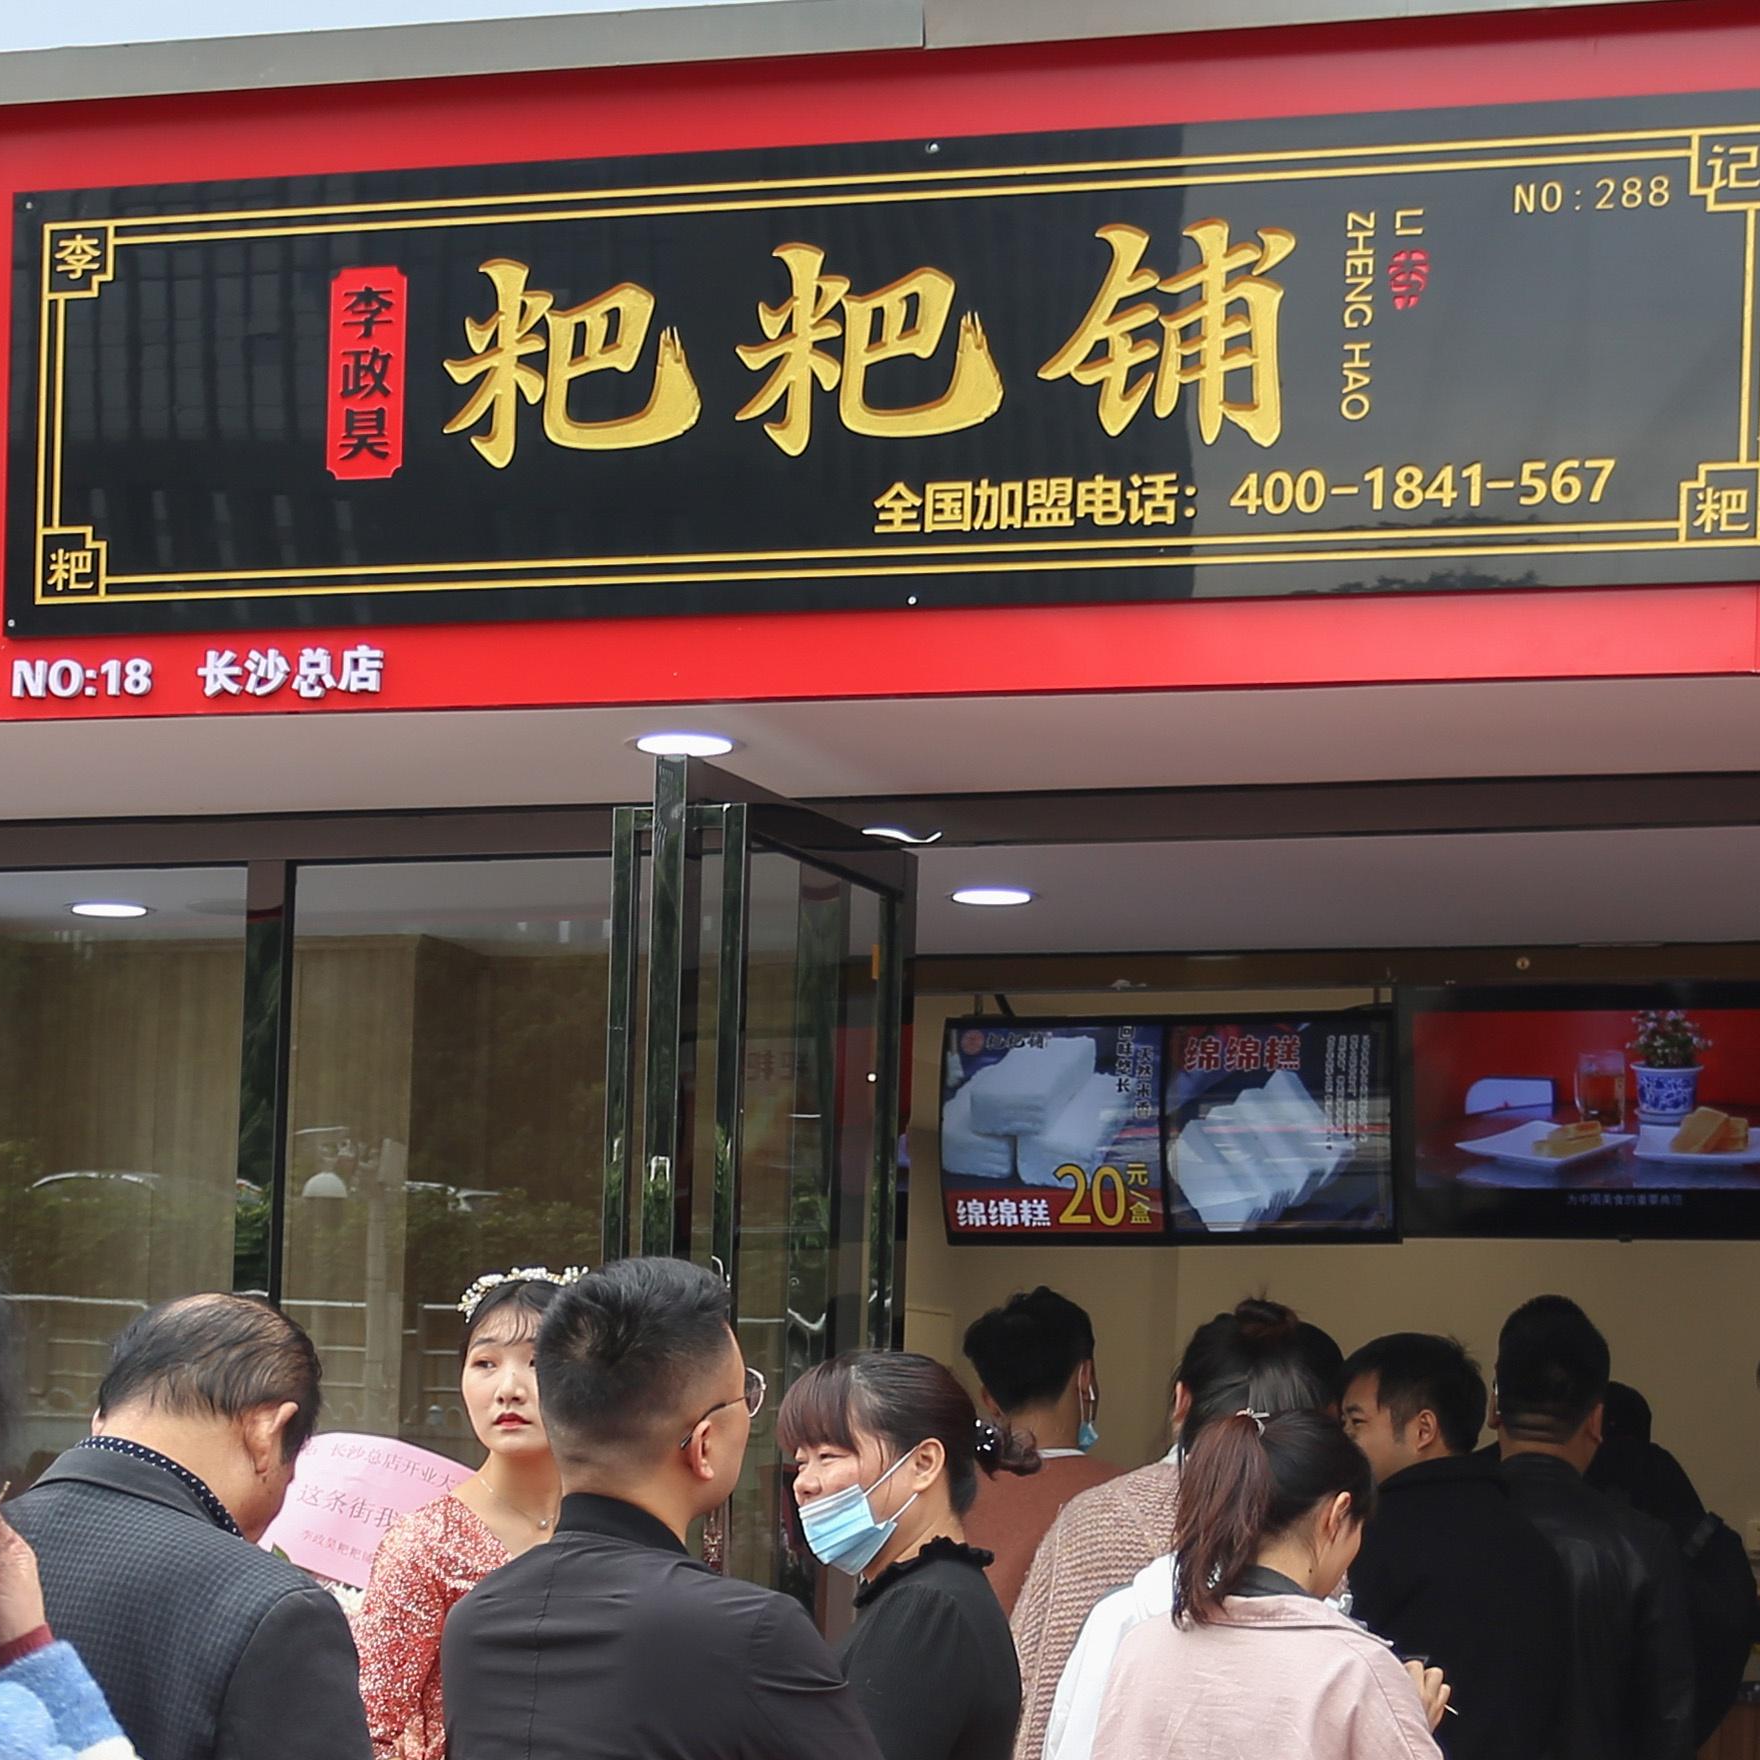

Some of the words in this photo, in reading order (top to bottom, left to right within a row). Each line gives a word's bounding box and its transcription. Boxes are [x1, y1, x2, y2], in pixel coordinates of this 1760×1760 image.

[1395, 208, 1424, 236] LI
[53, 235, 104, 281] 李
[1343, 210, 1376, 329] ZHENG
[442, 217, 1296, 470] 粑粑铺
[338, 285, 396, 462] 李政昊
[1340, 342, 1372, 421] HAO
[1228, 457, 1617, 517] 400-1841-567
[1696, 488, 1750, 534] 粑
[48, 549, 93, 593] 粑
[10, 656, 153, 701] NO:18
[197, 644, 385, 700] 长沙总店
[1184, 1034, 1301, 1072] 绵绵糕
[956, 1198, 1052, 1228] 绵绵糕
[1052, 1162, 1126, 1227] 20
[330, 1441, 460, 1493] 长沙总店开业大
